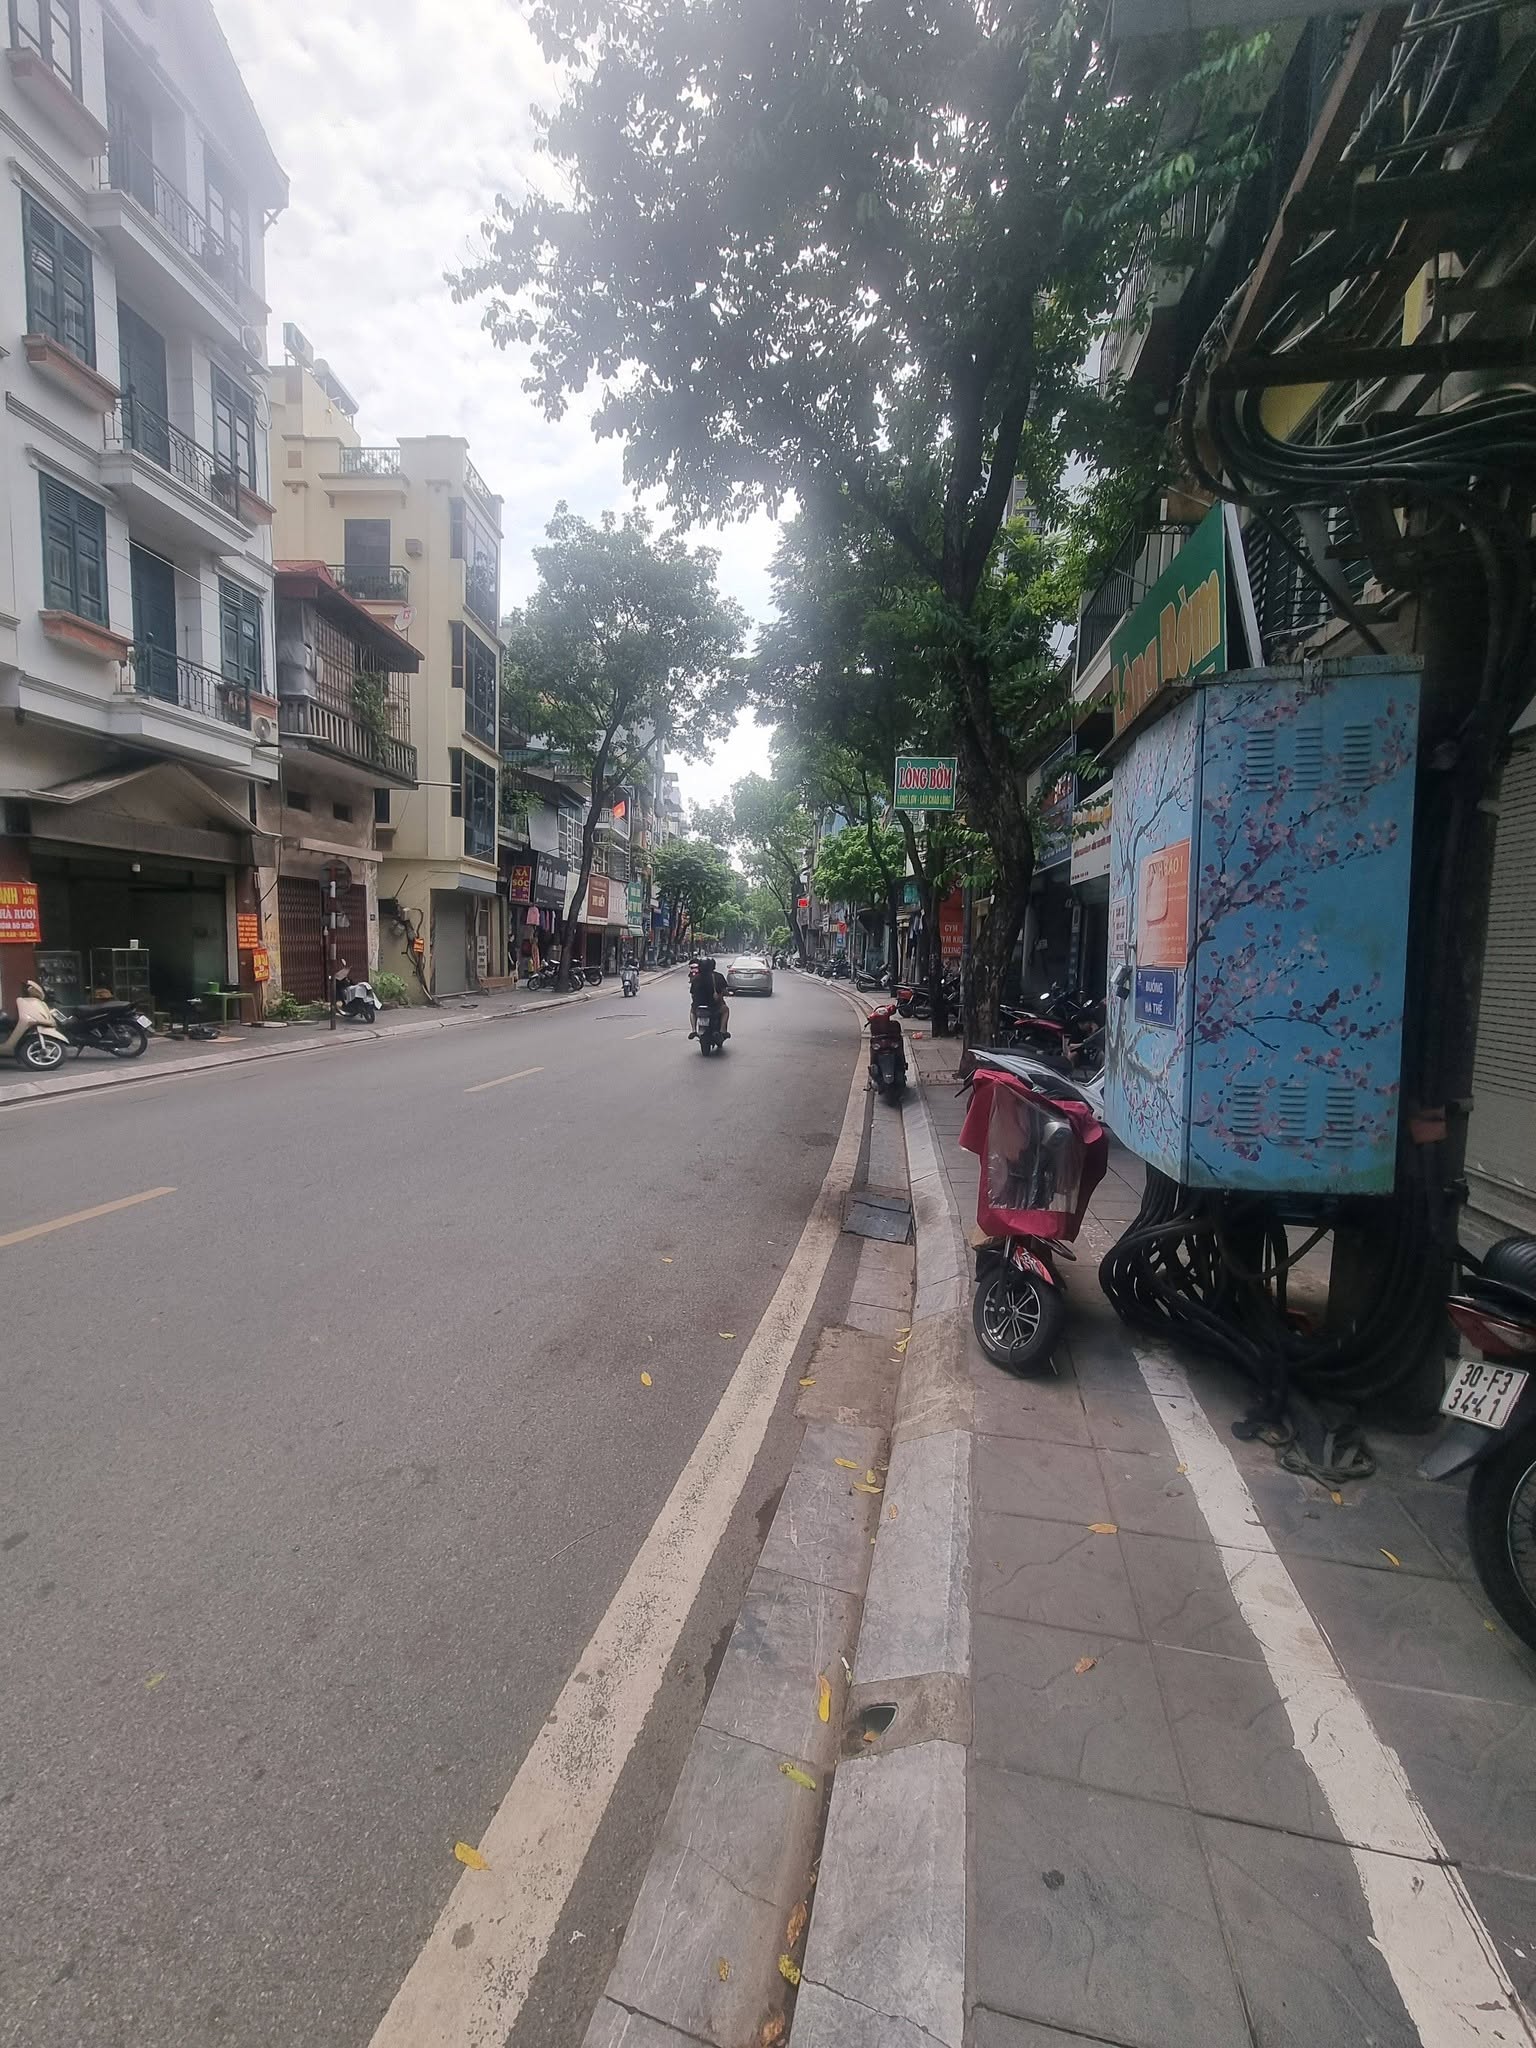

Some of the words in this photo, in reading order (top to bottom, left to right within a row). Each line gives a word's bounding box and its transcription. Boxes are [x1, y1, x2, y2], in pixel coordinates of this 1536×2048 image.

[1160, 569, 1220, 682] Bờm
[898, 760, 928, 789] LÒNG
[928, 761, 953, 789] BỜM
